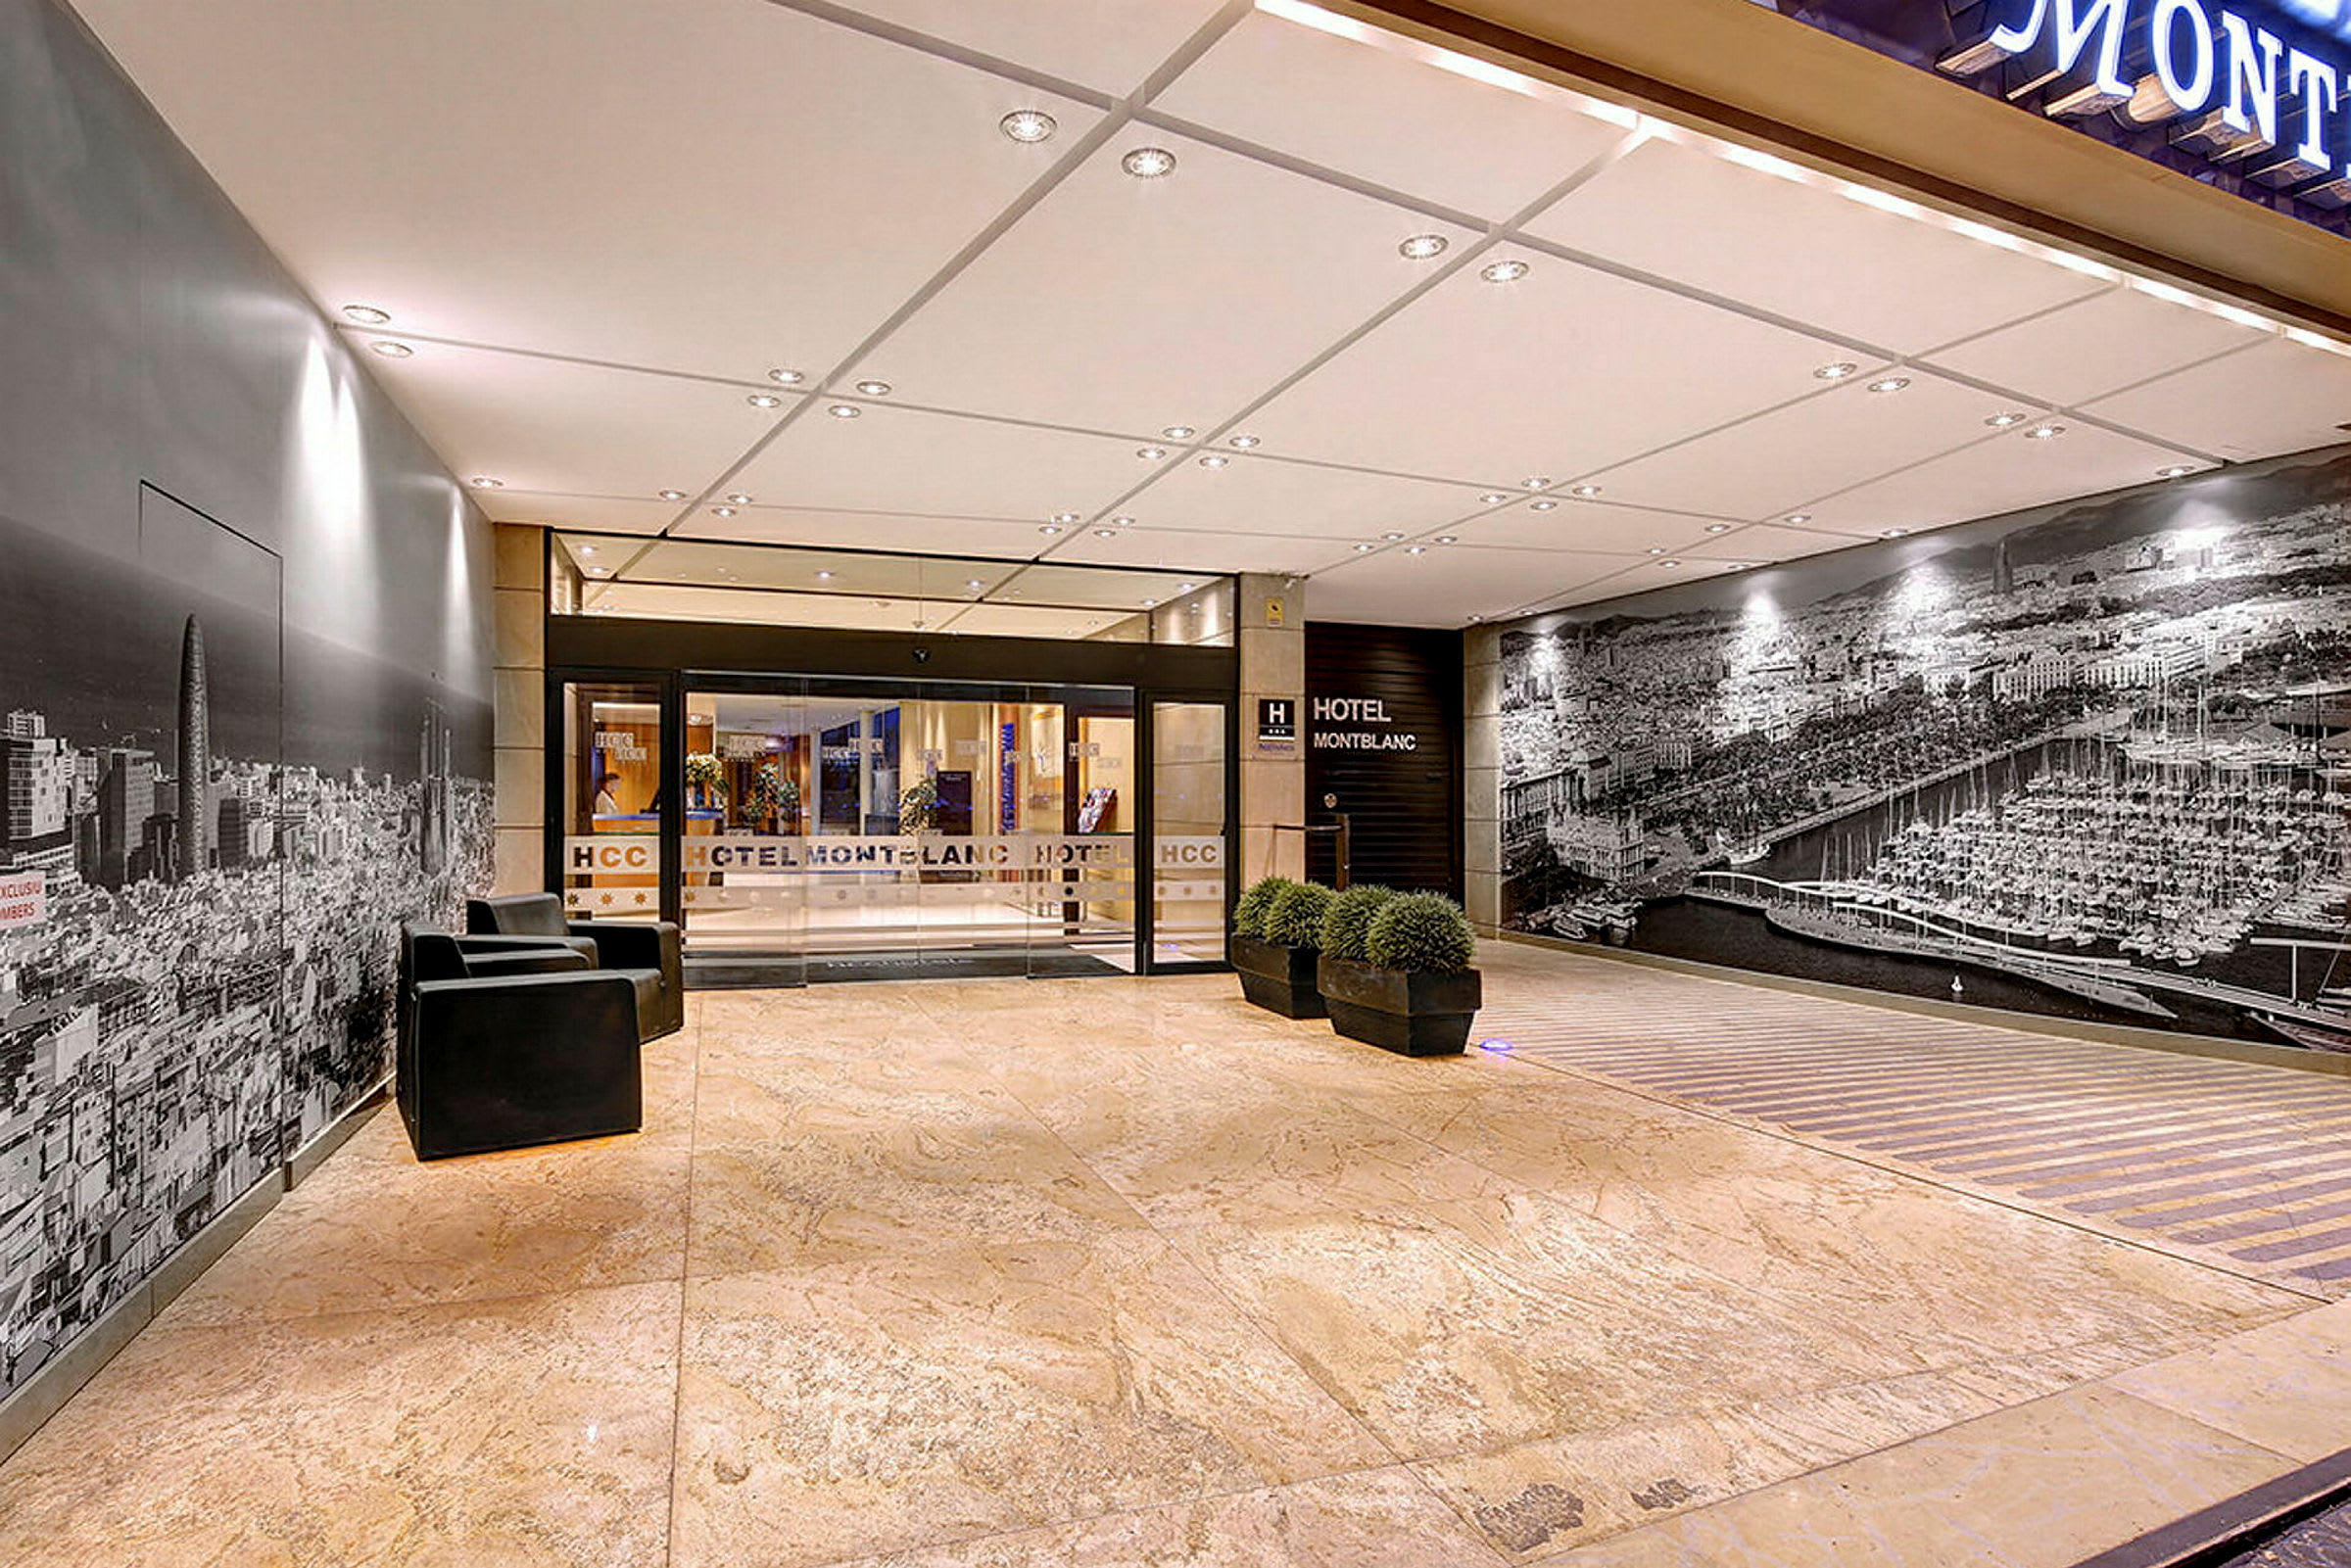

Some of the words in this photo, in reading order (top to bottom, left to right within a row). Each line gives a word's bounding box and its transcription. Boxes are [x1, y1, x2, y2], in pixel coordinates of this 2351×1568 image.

[1987, 0, 2351, 182] MONT
[1269, 702, 1285, 724] H
[1313, 697, 1392, 723] HOTEL
[1313, 733, 1416, 750] MONTBLANC
[573, 846, 648, 868] HCC
[687, 845, 798, 867] HOTEL
[806, 844, 1008, 865] MONTBLANC
[1035, 844, 1128, 863] HOTEL
[1160, 844, 1217, 863] HCC
[0, 880, 42, 899] XCLUSIU
[0, 902, 35, 919] MBERS
